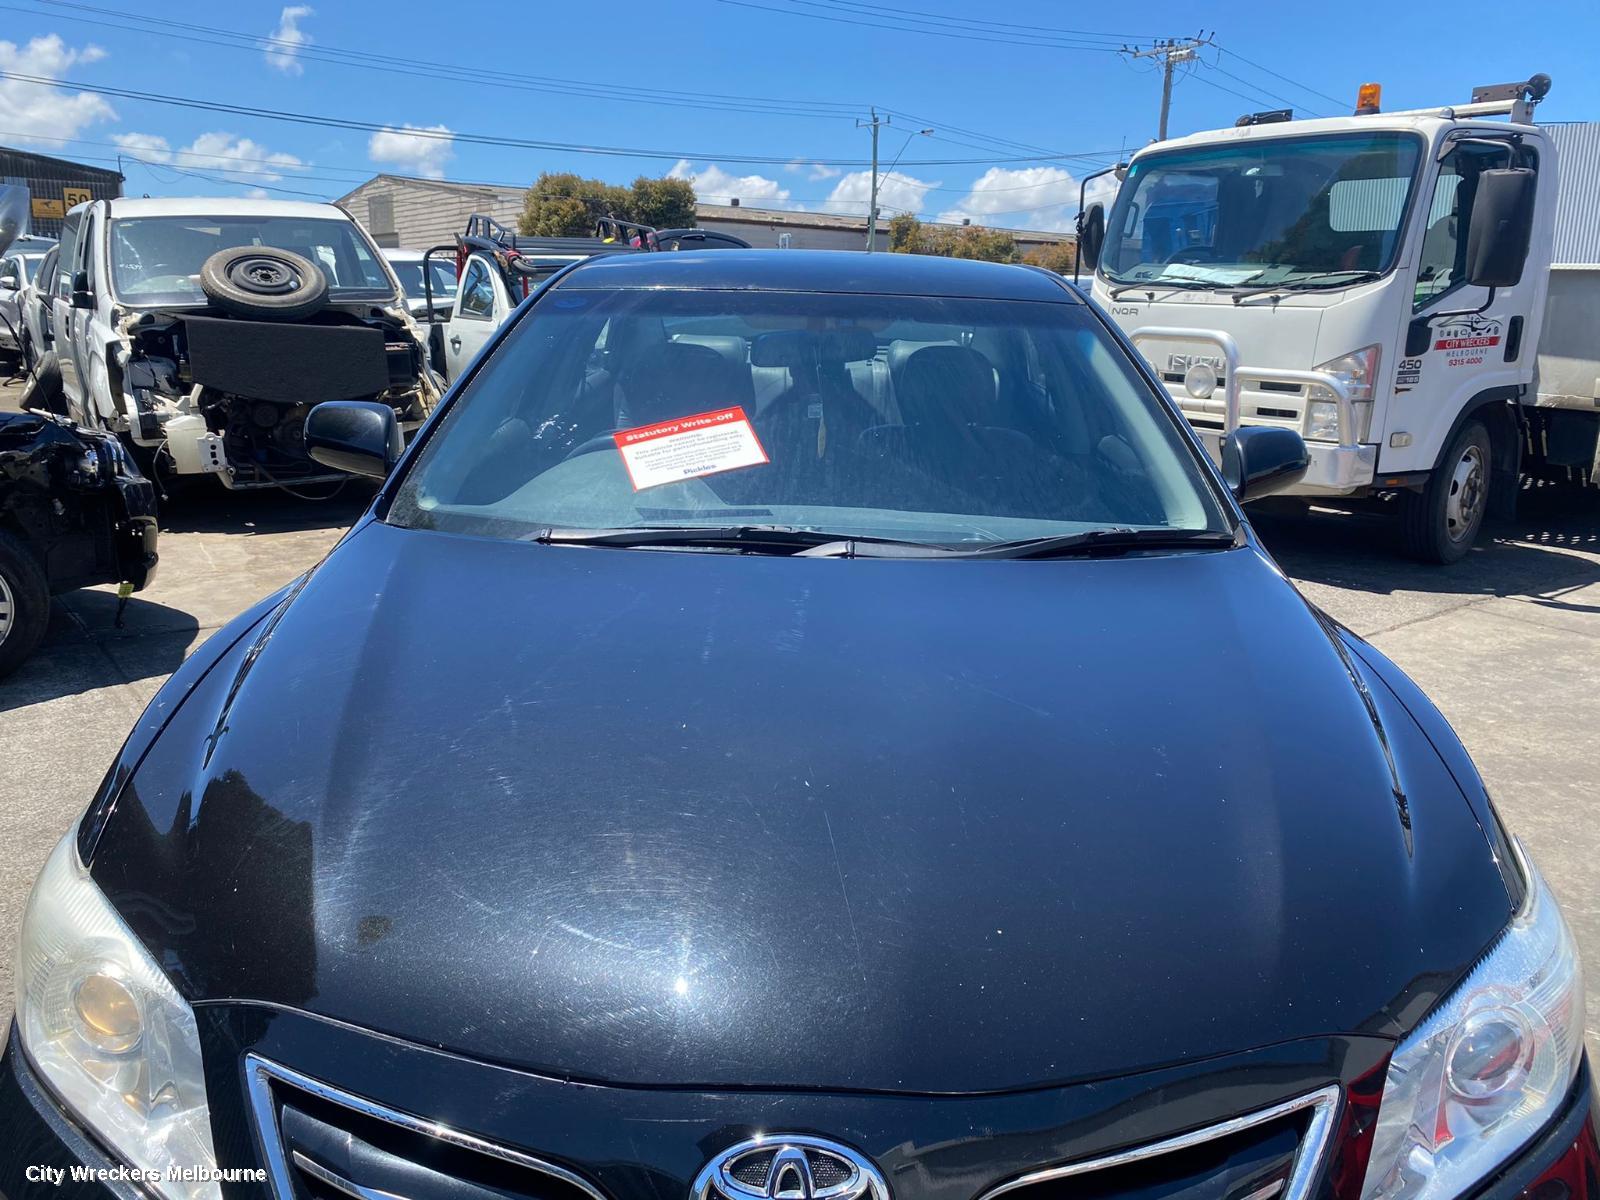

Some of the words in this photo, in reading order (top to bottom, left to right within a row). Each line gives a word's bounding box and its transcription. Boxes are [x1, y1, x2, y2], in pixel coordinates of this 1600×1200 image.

[1112, 307, 1139, 316] NQR
[1445, 340, 1460, 349] CITY
[1460, 337, 1490, 347] WRECKERS
[1446, 347, 1489, 357] MELBOURNE
[1398, 359, 1422, 370] 450
[625, 425, 680, 441] Statutory
[680, 412, 735, 428] Write-Off
